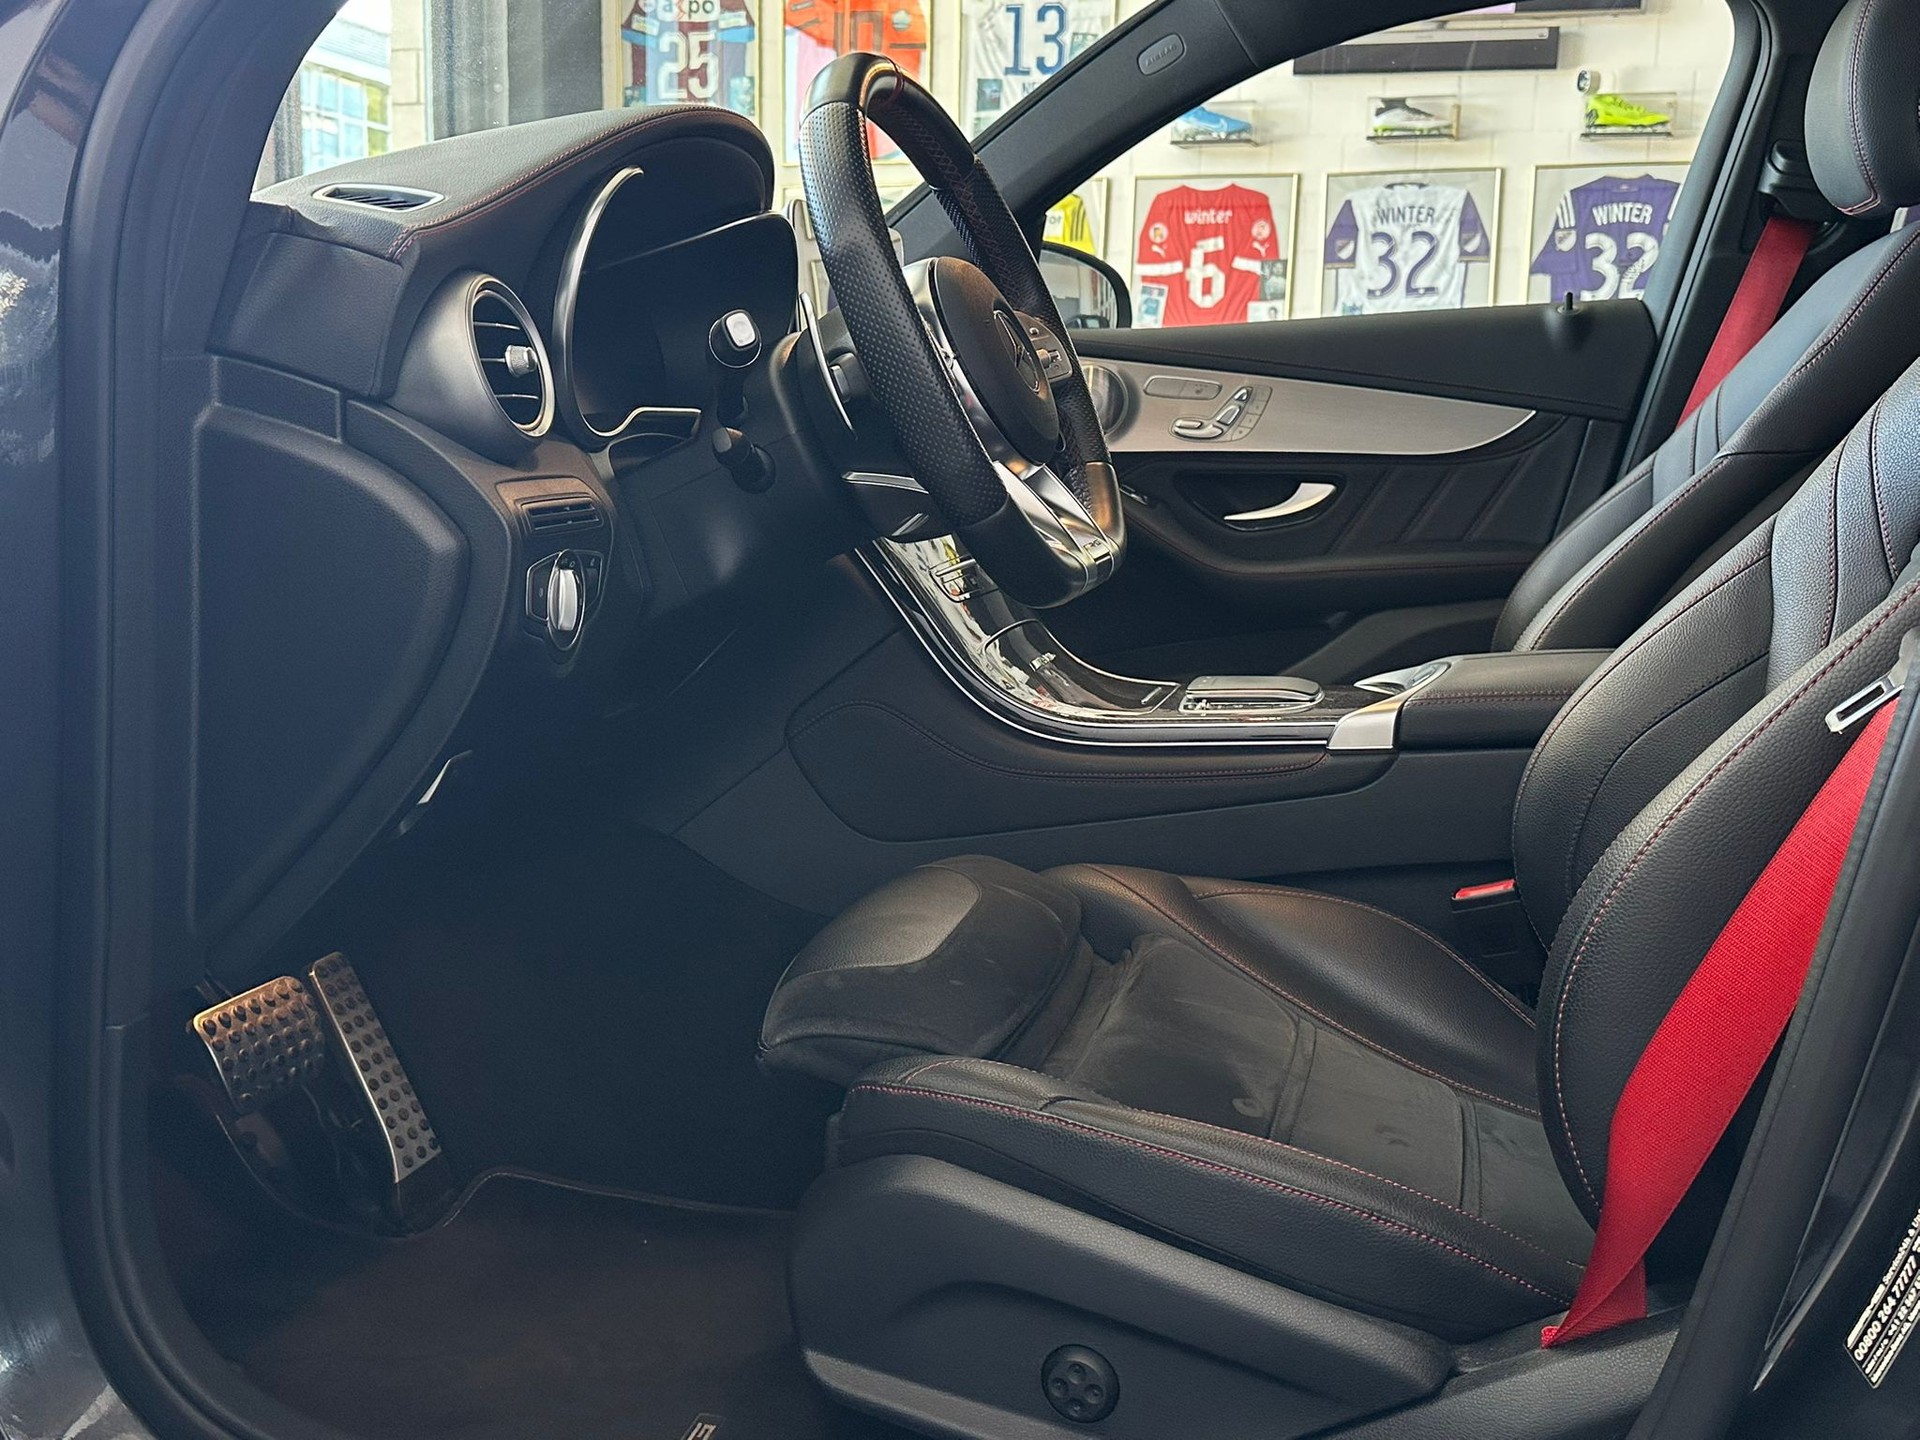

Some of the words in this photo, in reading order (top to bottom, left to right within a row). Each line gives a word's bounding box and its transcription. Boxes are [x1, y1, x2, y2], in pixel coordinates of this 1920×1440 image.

[657, 30, 719, 100] 25
[1003, 3, 1067, 76] 13
[1184, 209, 1233, 224] winter
[1376, 205, 1437, 225] WINTER
[1592, 202, 1653, 226] WINTER
[1186, 235, 1225, 309] 6
[1367, 230, 1439, 299] 32
[1579, 231, 1660, 301] 32
[1853, 1320, 1882, 1362] 00800
[1877, 1295, 1897, 1324] 264
[1890, 1254, 1917, 1299] 77777
